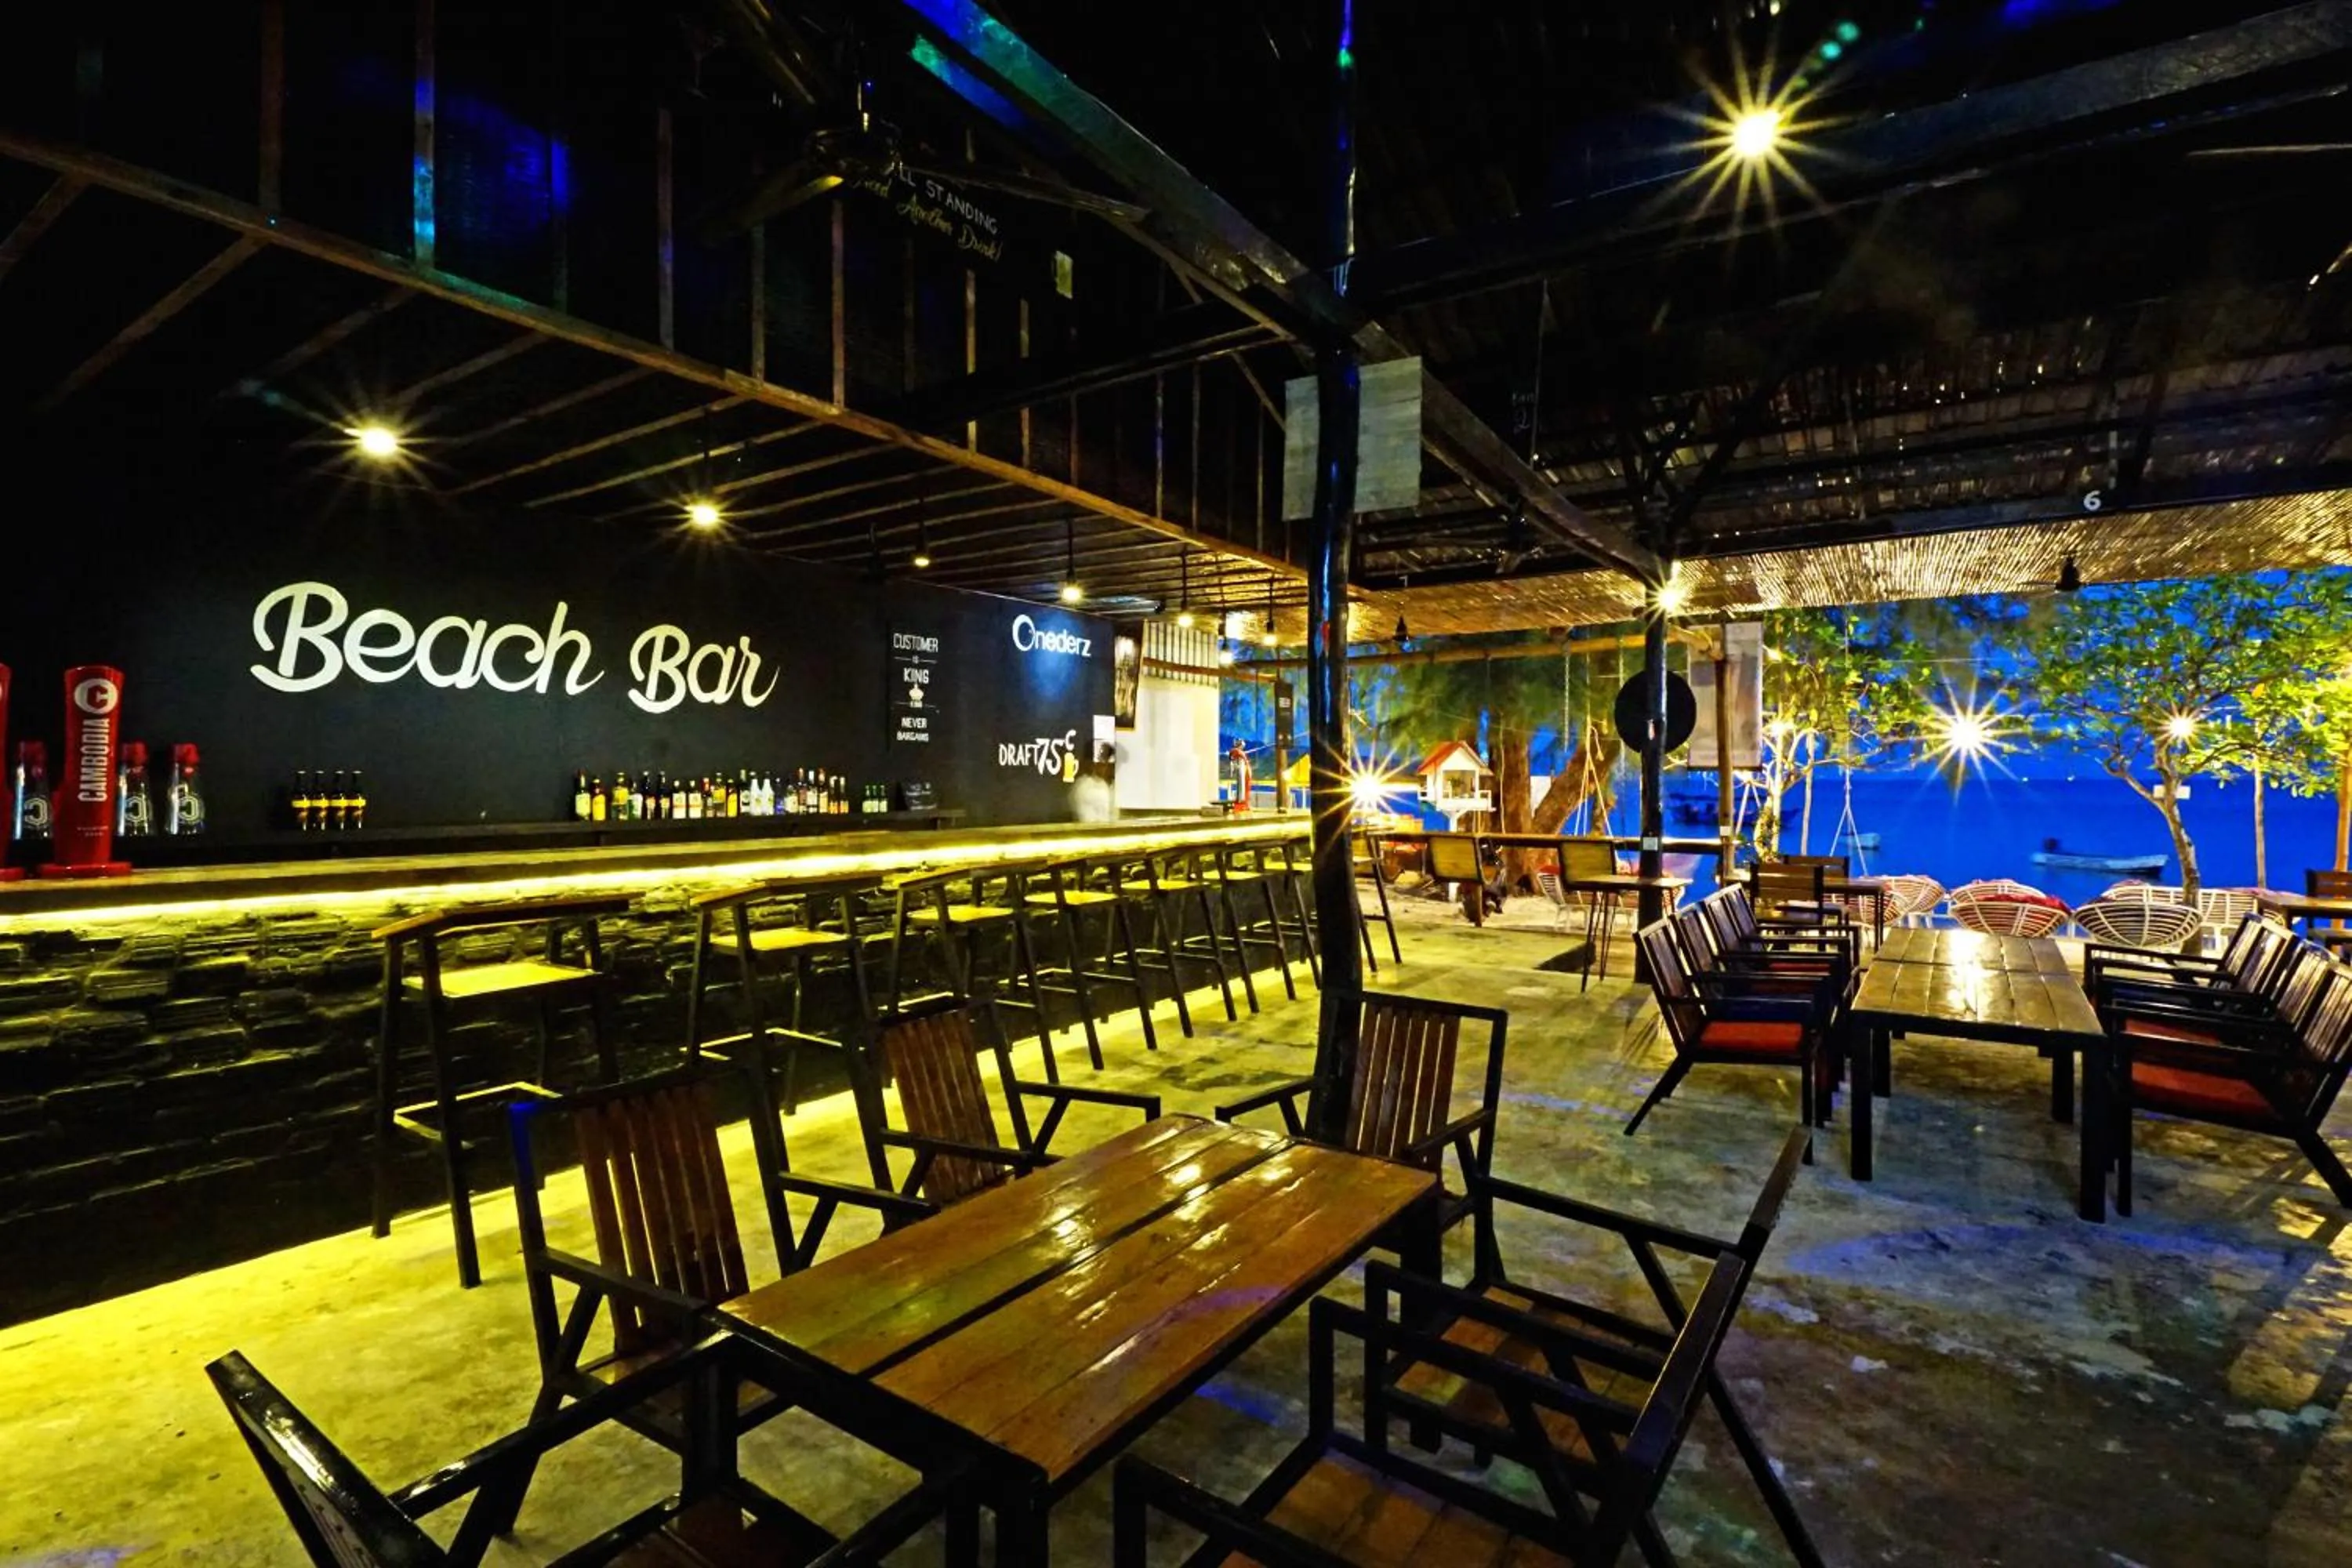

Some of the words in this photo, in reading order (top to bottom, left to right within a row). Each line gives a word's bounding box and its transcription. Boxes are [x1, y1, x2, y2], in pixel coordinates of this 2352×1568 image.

[924, 179, 999, 235] STANDING
[2083, 490, 2102, 510] 6
[250, 581, 604, 695] Beach
[628, 624, 779, 713] Bar
[893, 633, 938, 652] CUSTOMER
[1012, 614, 1092, 657] Onederz
[903, 667, 929, 684] KING
[902, 717, 927, 728] NEVER
[78, 718, 111, 802] CAMBODIA
